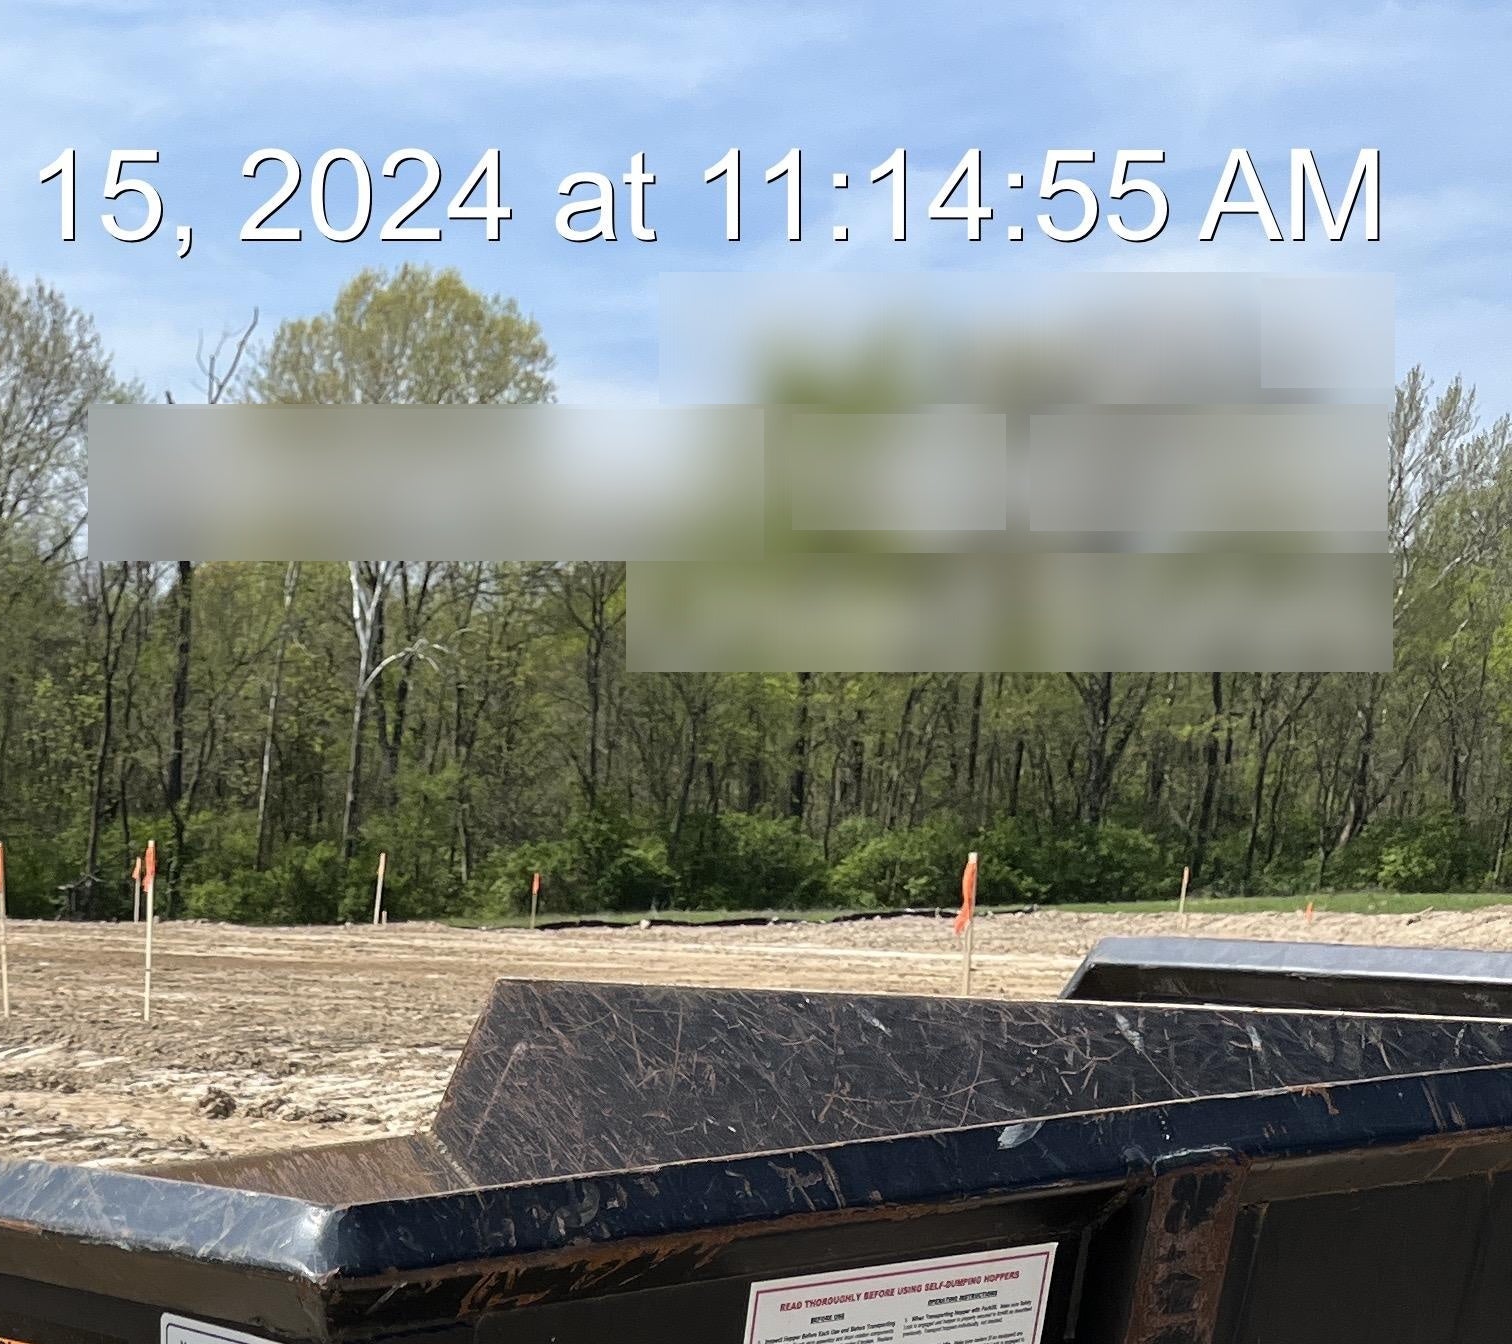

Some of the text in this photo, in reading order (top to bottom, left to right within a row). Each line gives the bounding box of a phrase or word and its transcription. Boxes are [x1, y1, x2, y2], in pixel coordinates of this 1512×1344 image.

[780, 1271, 1019, 1311] READ THOROUGHLY BEFORE USING SELF-DUMPING HOPPERS
